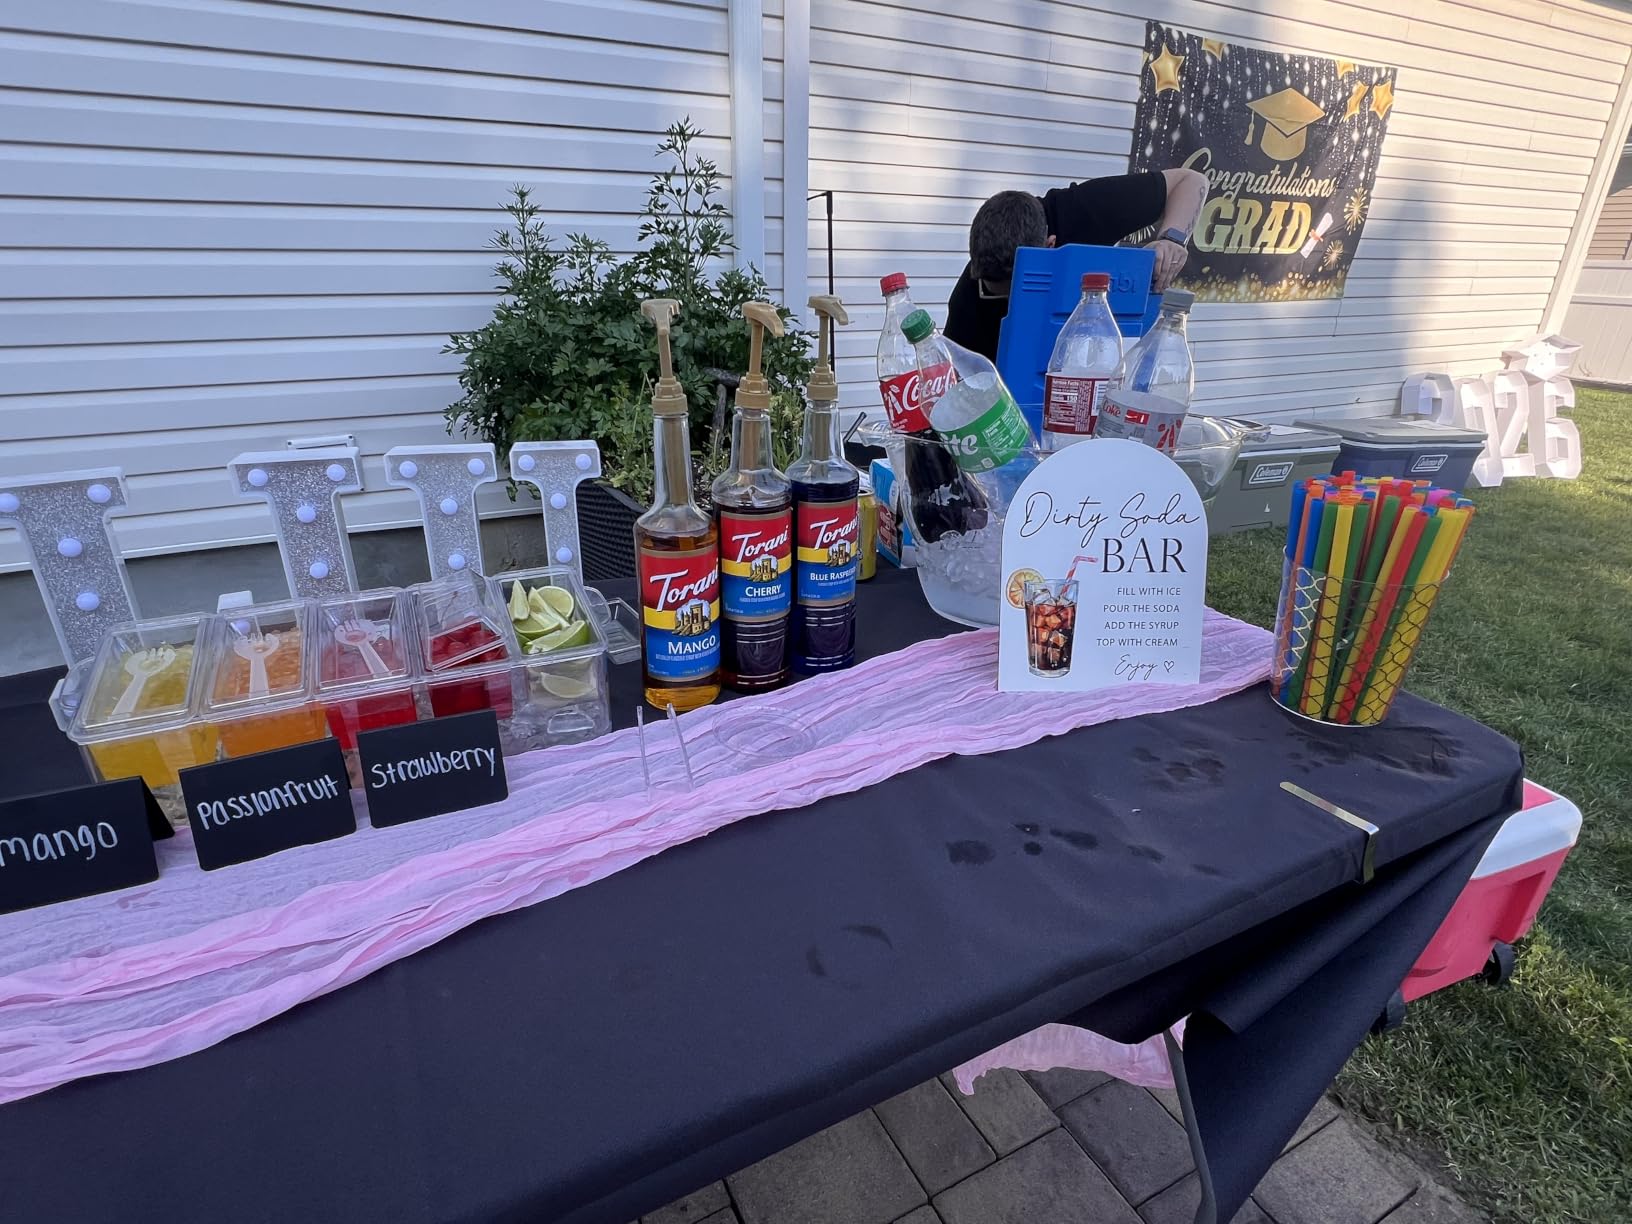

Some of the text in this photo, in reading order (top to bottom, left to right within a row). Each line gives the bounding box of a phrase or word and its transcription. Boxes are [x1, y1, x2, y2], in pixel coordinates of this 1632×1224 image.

[1193, 197, 1312, 254] GRAD
[940, 433, 978, 456] ite
[1020, 491, 1199, 548] Dirty Soda
[732, 525, 788, 563] Torani
[1102, 538, 1187, 573] BAR
[650, 557, 719, 612] Torani
[745, 584, 782, 597] CHERRY
[1117, 588, 1181, 596] FILL WITH ICE
[1103, 605, 1180, 613] POUR THE SODA
[1104, 621, 1179, 630] ADD THE SYRUP
[668, 635, 716, 654] MANGO
[1097, 638, 1178, 647] TOP WITH CREAM
[1114, 654, 1158, 681] Enjoy
[0, 822, 118, 867] mango
